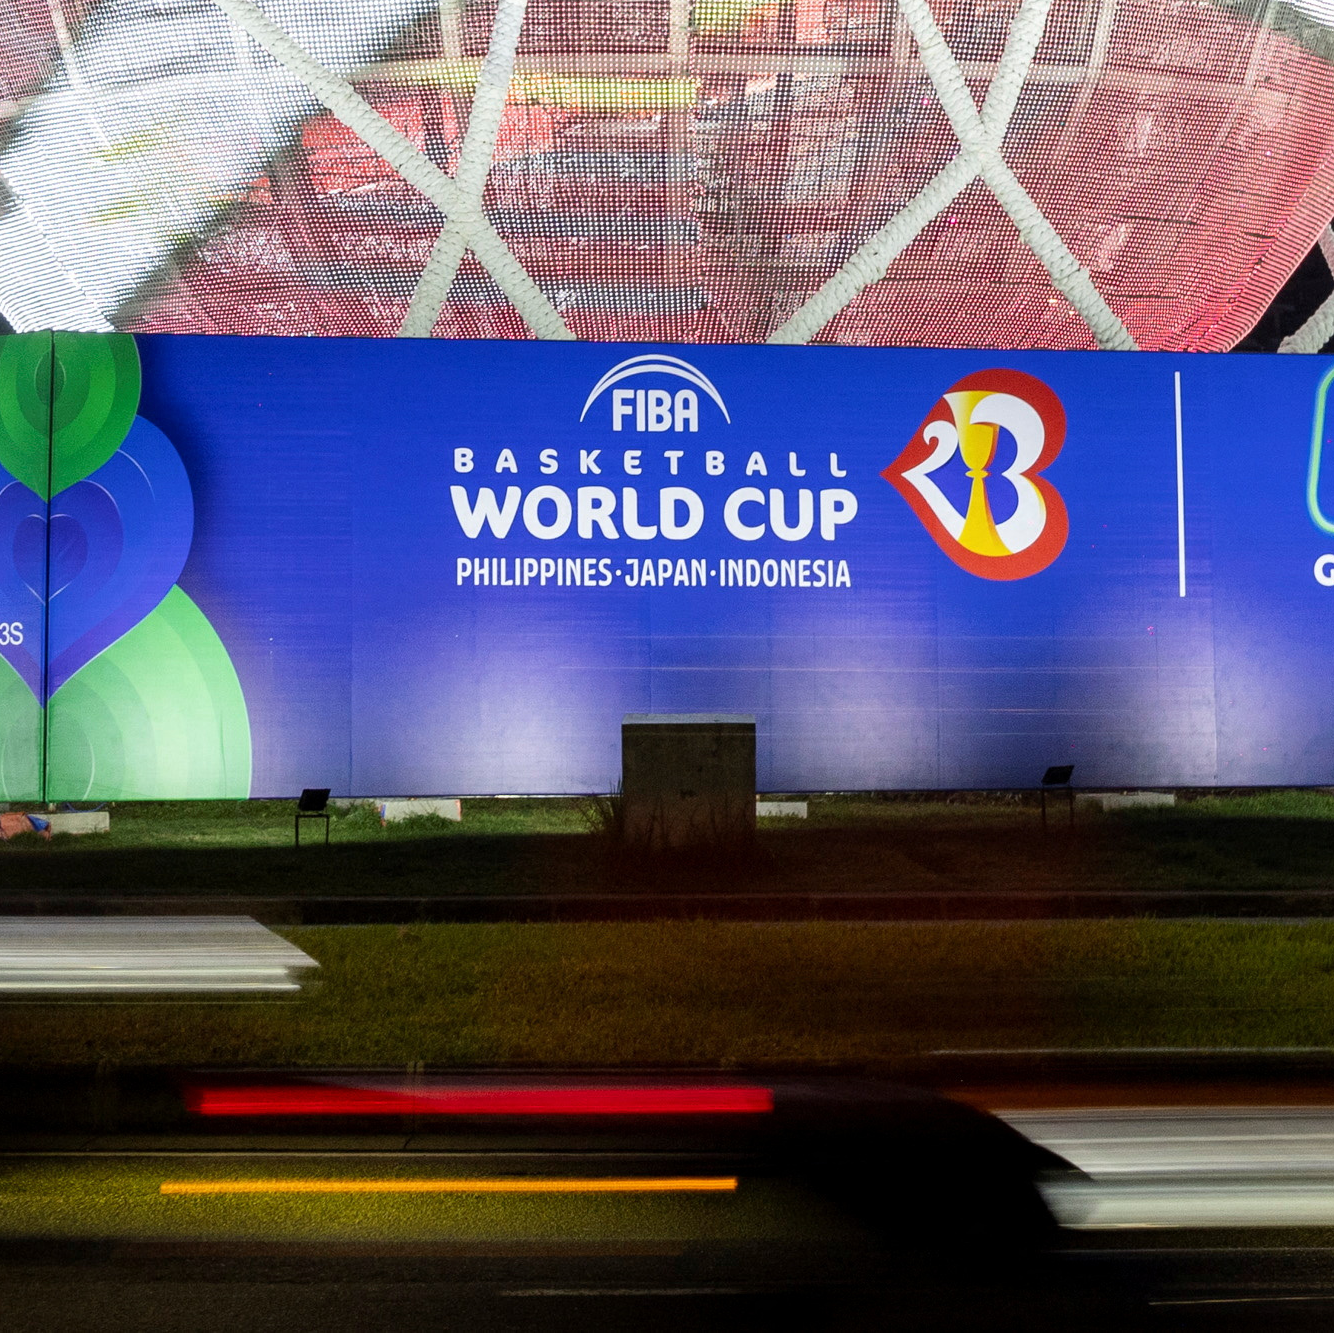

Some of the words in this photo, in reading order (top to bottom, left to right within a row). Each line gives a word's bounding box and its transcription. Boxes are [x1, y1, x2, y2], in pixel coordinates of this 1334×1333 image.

[612, 388, 699, 433] FIBA
[453, 447, 847, 478] BASKETBALL
[449, 485, 705, 541] WORLD
[723, 486, 858, 542] CUP
